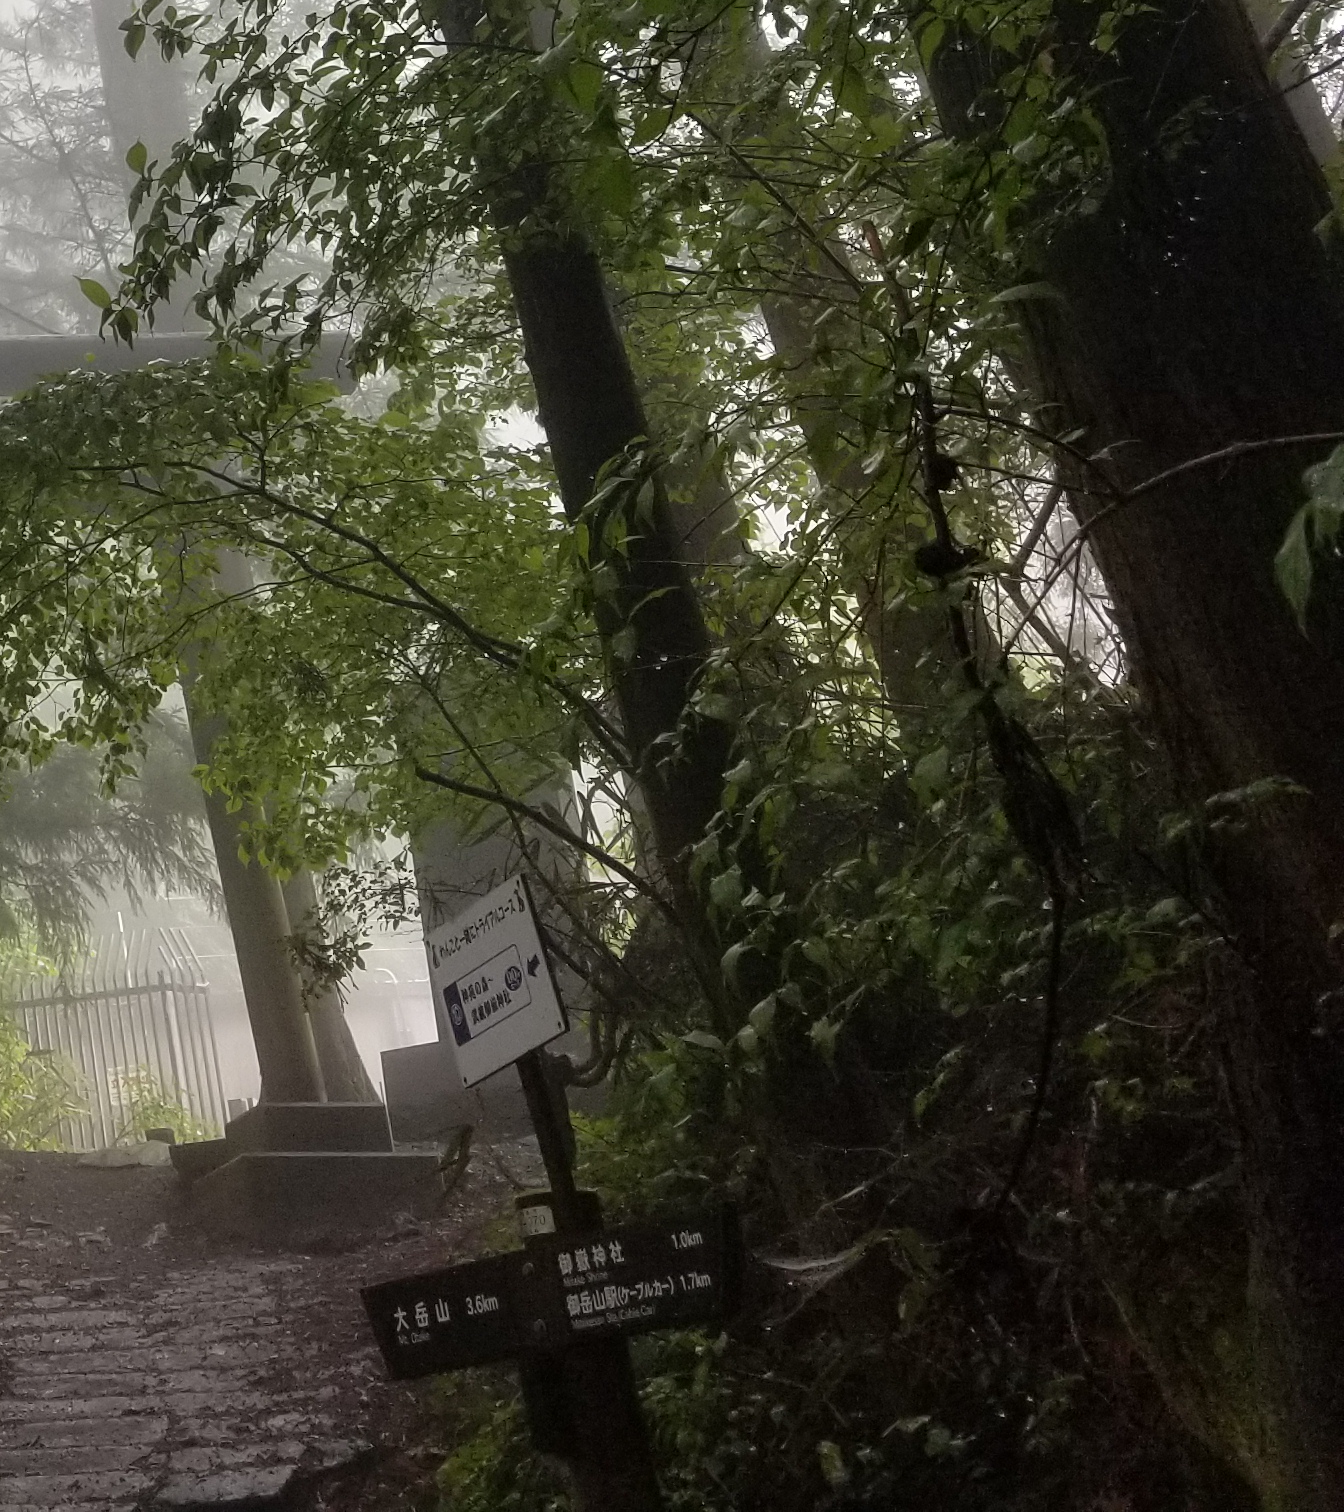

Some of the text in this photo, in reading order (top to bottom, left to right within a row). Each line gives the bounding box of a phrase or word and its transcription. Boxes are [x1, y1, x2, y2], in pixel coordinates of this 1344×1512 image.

[558, 1230, 703, 1276] 御嶽神社 1.0km
[679, 1272, 711, 1291] 1.7km
[394, 1294, 499, 1332] 大岳山 3.6km
